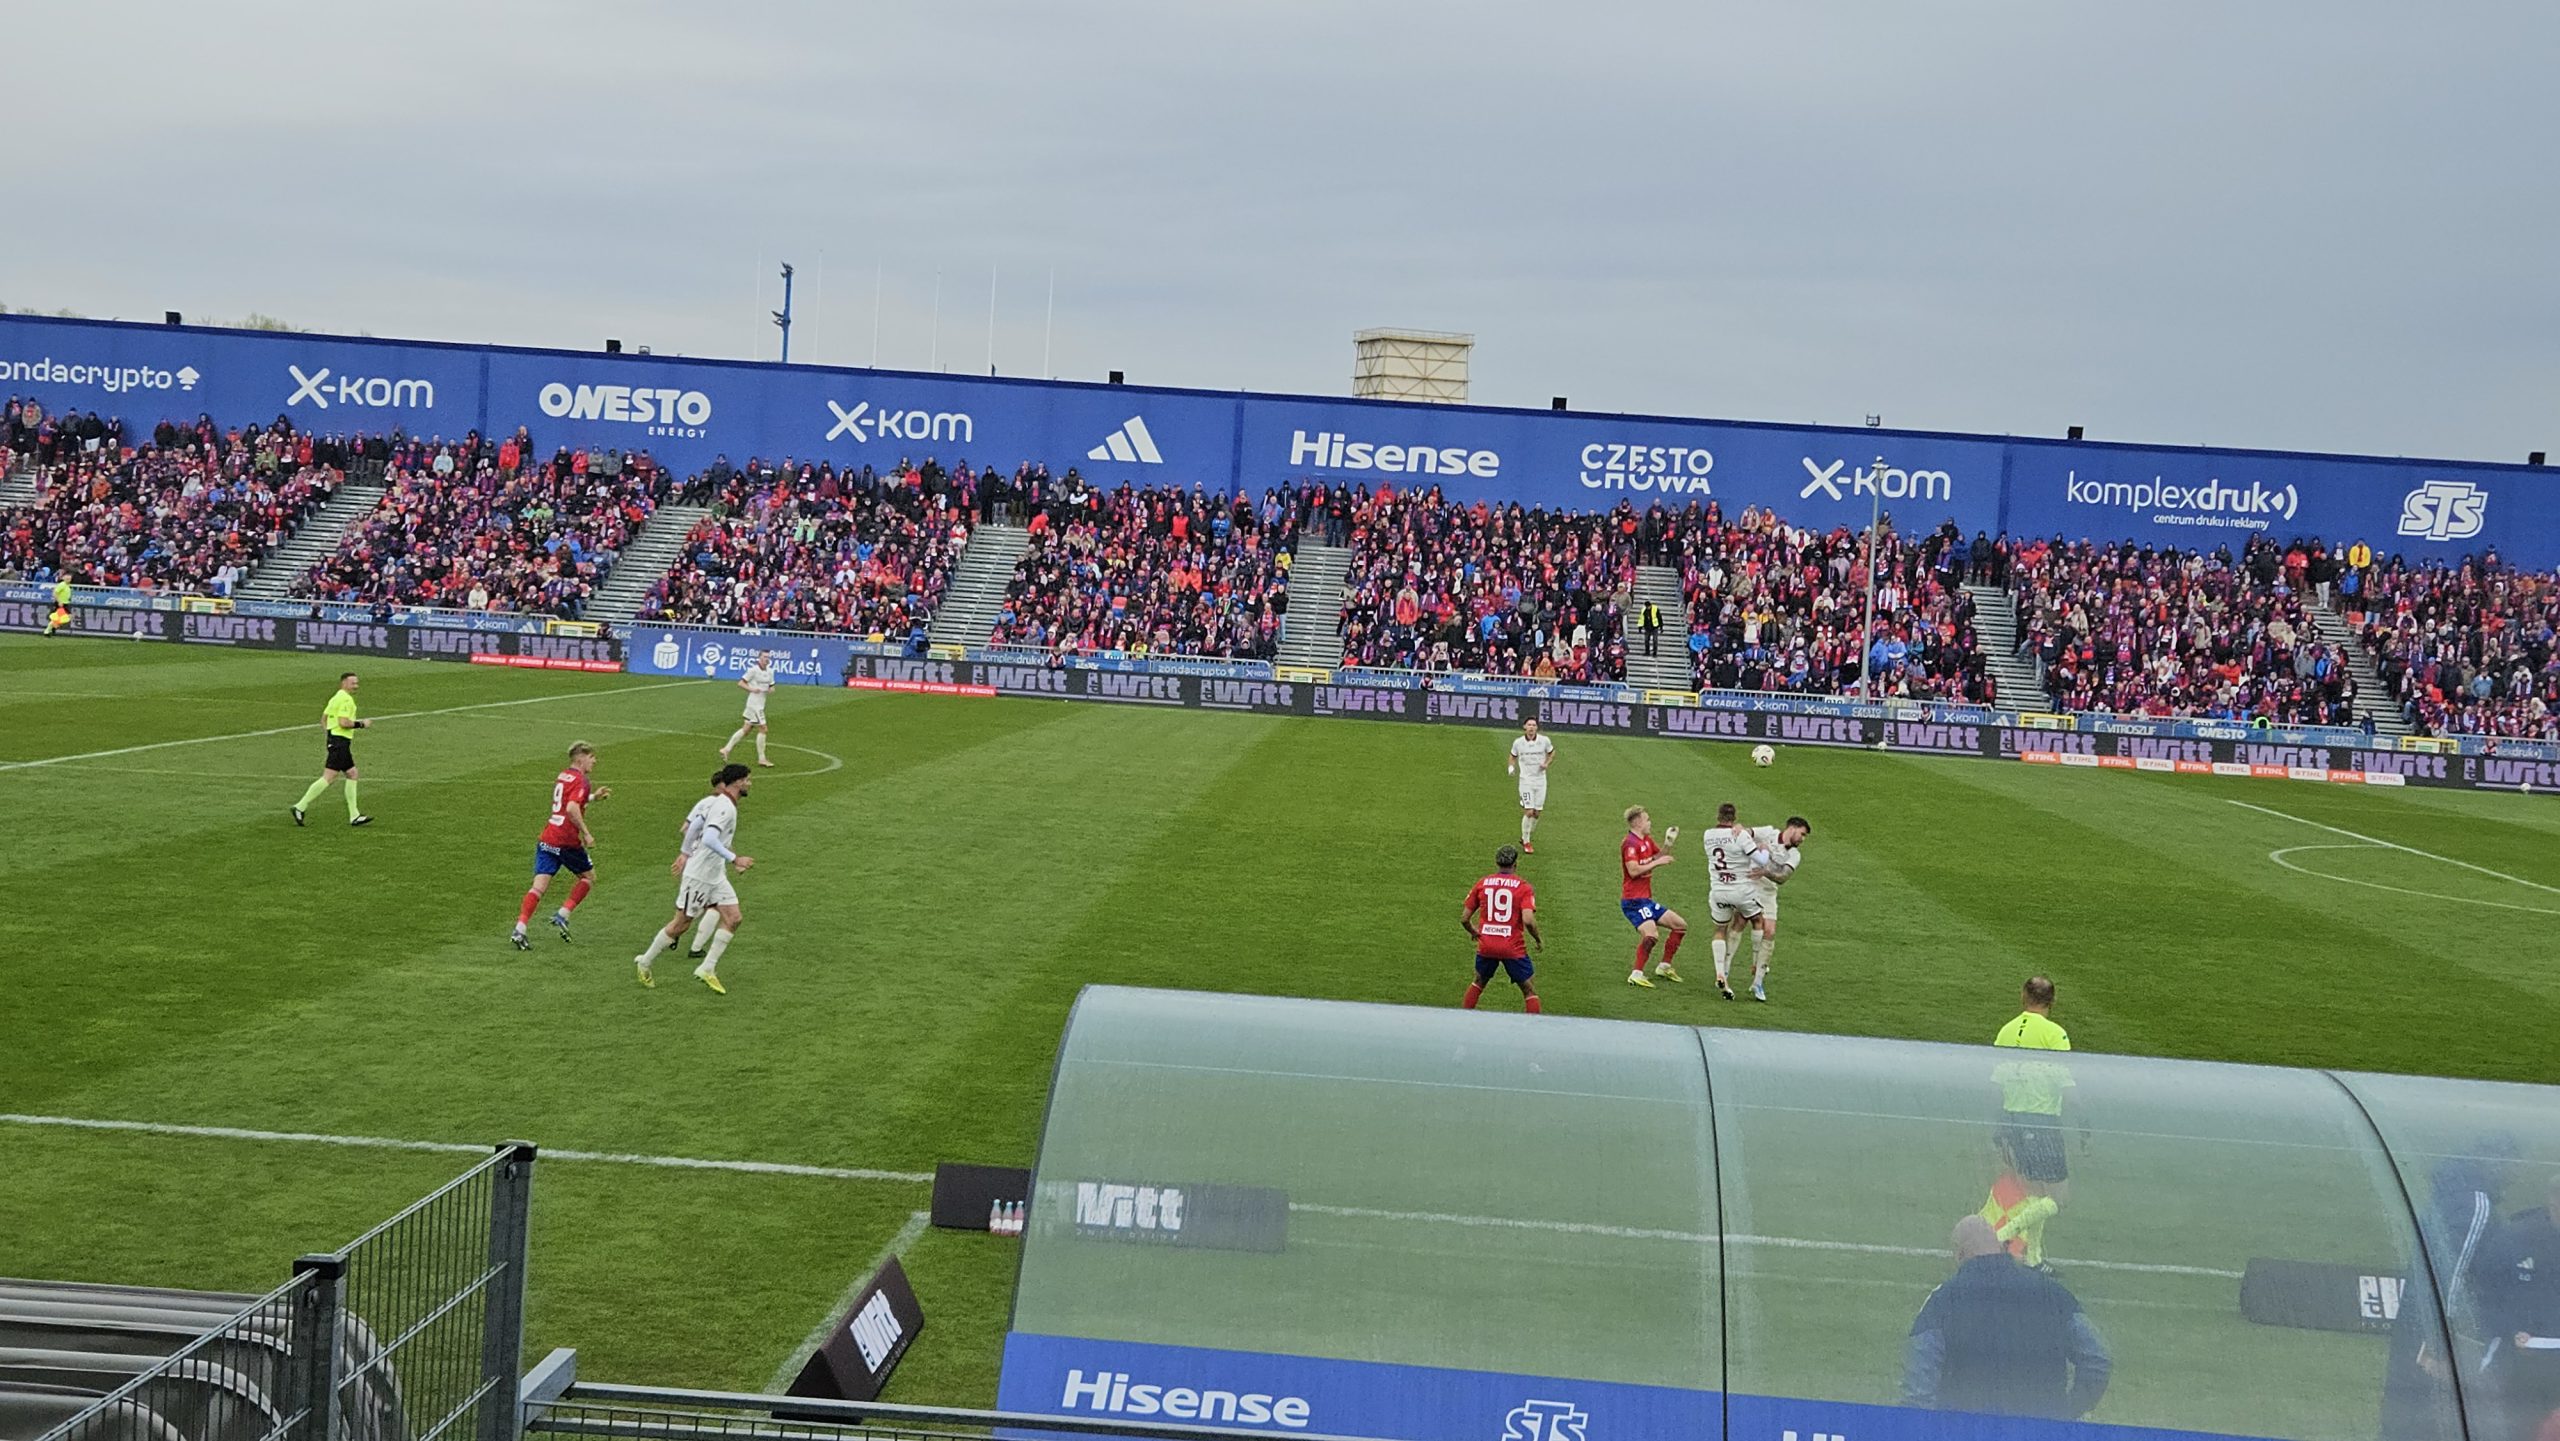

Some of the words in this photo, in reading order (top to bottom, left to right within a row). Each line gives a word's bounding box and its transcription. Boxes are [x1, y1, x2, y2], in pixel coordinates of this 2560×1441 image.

[539, 383, 711, 426] ONESTO
[649, 426, 706, 438] ENERGY
[1290, 430, 1499, 477] Hisense
[2067, 470, 2270, 513] komplexdruk
[2153, 513, 2196, 525] centrum
[2196, 514, 2226, 527] druku
[2229, 518, 2270, 531] reklamy
[2397, 480, 2488, 541] STS
[0, 603, 53, 626] itt
[84, 608, 164, 634] Witt
[197, 615, 276, 641] Witt
[308, 622, 389, 649] Witt
[421, 629, 500, 654] Witt
[532, 635, 611, 661] Witt
[875, 658, 954, 684] Witt
[988, 665, 1067, 692] Witt
[1100, 672, 1181, 699] Witt
[1214, 680, 1294, 707] Witt
[1326, 687, 1406, 713] Witt
[1439, 694, 1519, 721] Witt
[1551, 701, 1631, 728] Witt
[1667, 708, 1748, 735] Witt
[1781, 715, 1863, 742] Witt
[1898, 723, 1980, 750] Witt
[2197, 726, 2247, 740] ONESTO
[2013, 731, 2096, 755] Witt
[2130, 737, 2213, 762] Witt
[2028, 753, 2056, 762] STIHL
[2066, 756, 2092, 764] STIHL
[2102, 758, 2132, 767] STIHL
[2142, 760, 2169, 769] STIHL
[2179, 763, 2209, 771] STIHL
[2219, 765, 2246, 773] STIHL
[2247, 744, 2331, 770] Witt
[2363, 751, 2447, 778] Witt
[2255, 767, 2285, 776] STIHL
[2294, 770, 2322, 778] STIHL
[2332, 772, 2362, 781] STIHL
[552, 782, 564, 813] 9
[1713, 847, 1727, 871] 3
[693, 890, 705, 904] 14
[1484, 888, 1513, 923] 19
[1062, 1369, 1312, 1428] Hisense
